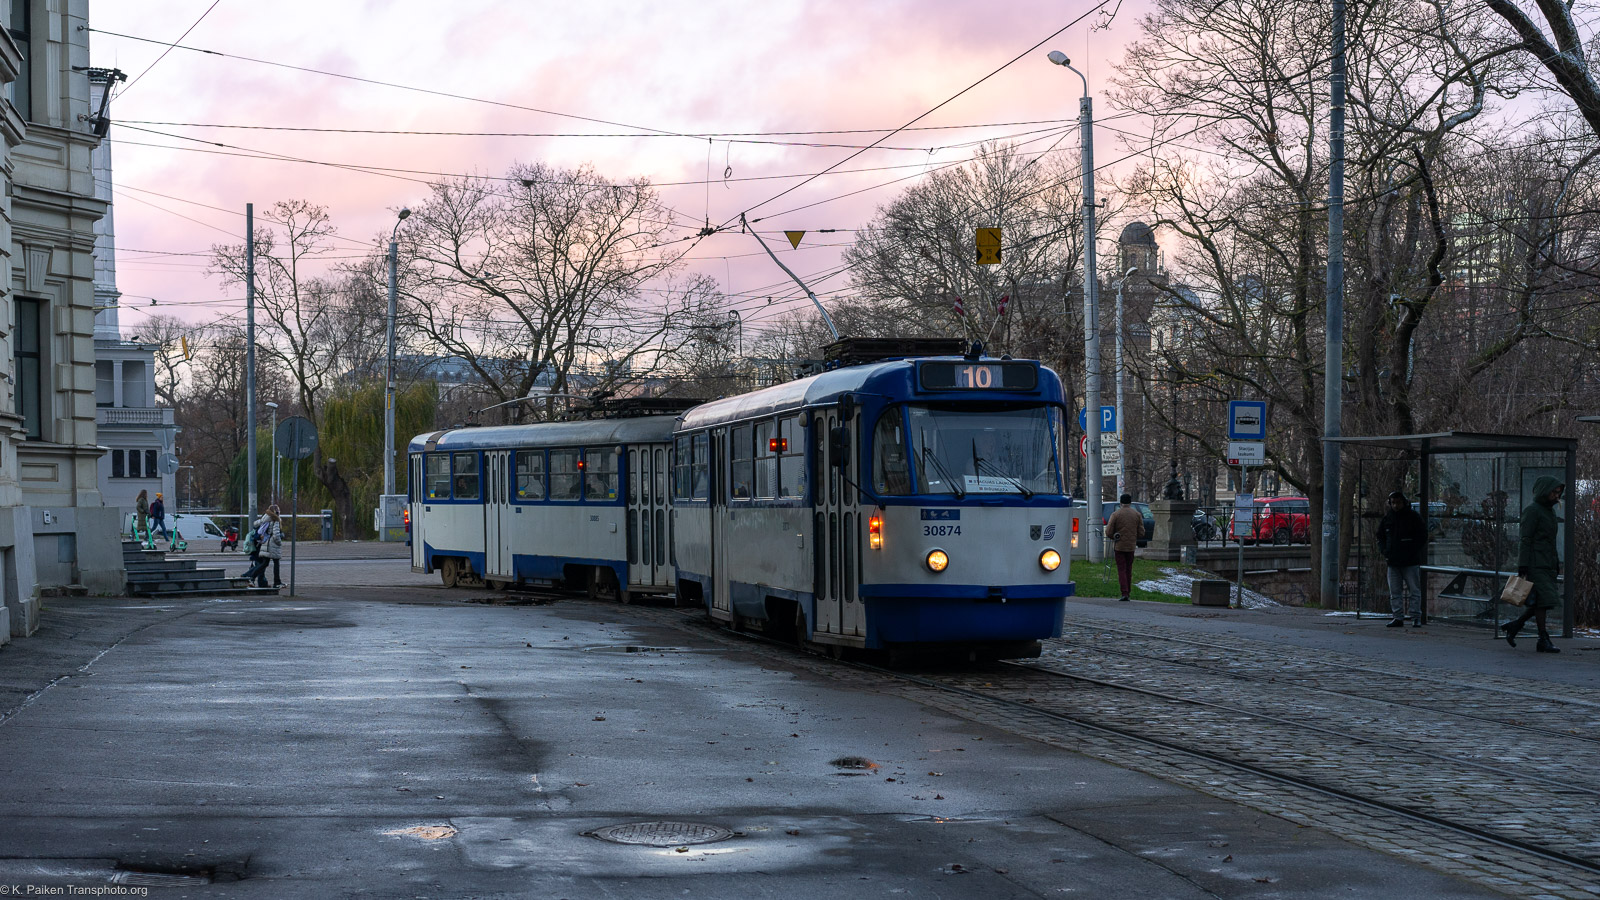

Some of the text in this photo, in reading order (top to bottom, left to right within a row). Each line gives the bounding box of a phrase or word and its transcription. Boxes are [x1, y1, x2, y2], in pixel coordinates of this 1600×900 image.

[962, 366, 992, 388] 10
[1103, 409, 1112, 429] P
[923, 525, 962, 536] 30874
